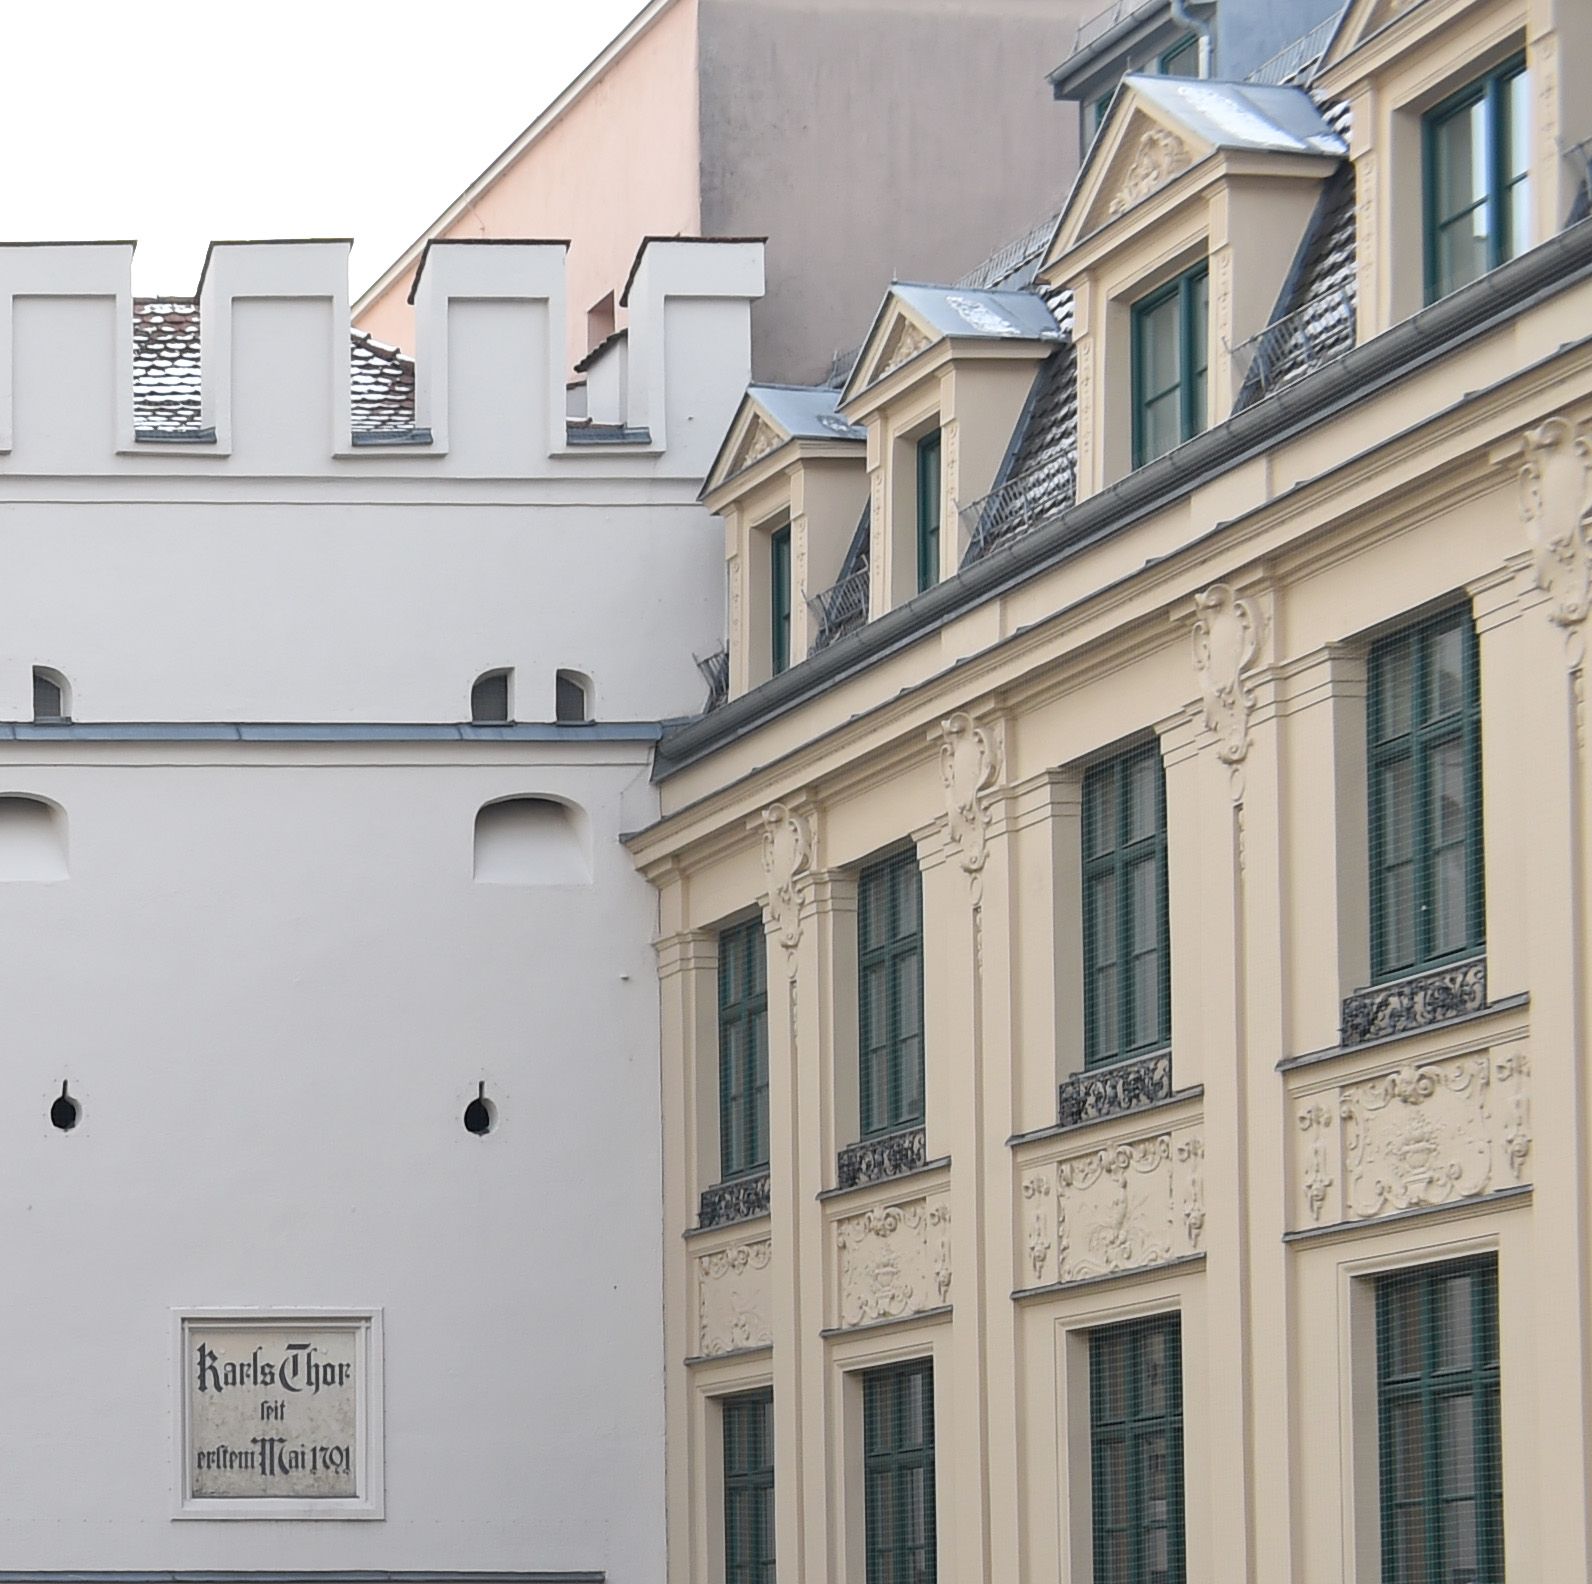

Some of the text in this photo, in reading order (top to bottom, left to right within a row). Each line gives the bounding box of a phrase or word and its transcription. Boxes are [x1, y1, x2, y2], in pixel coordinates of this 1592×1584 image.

[197, 1343, 351, 1395] Karls Thor
[251, 1437, 306, 1477] Mai
[310, 1445, 351, 1476] 1791
